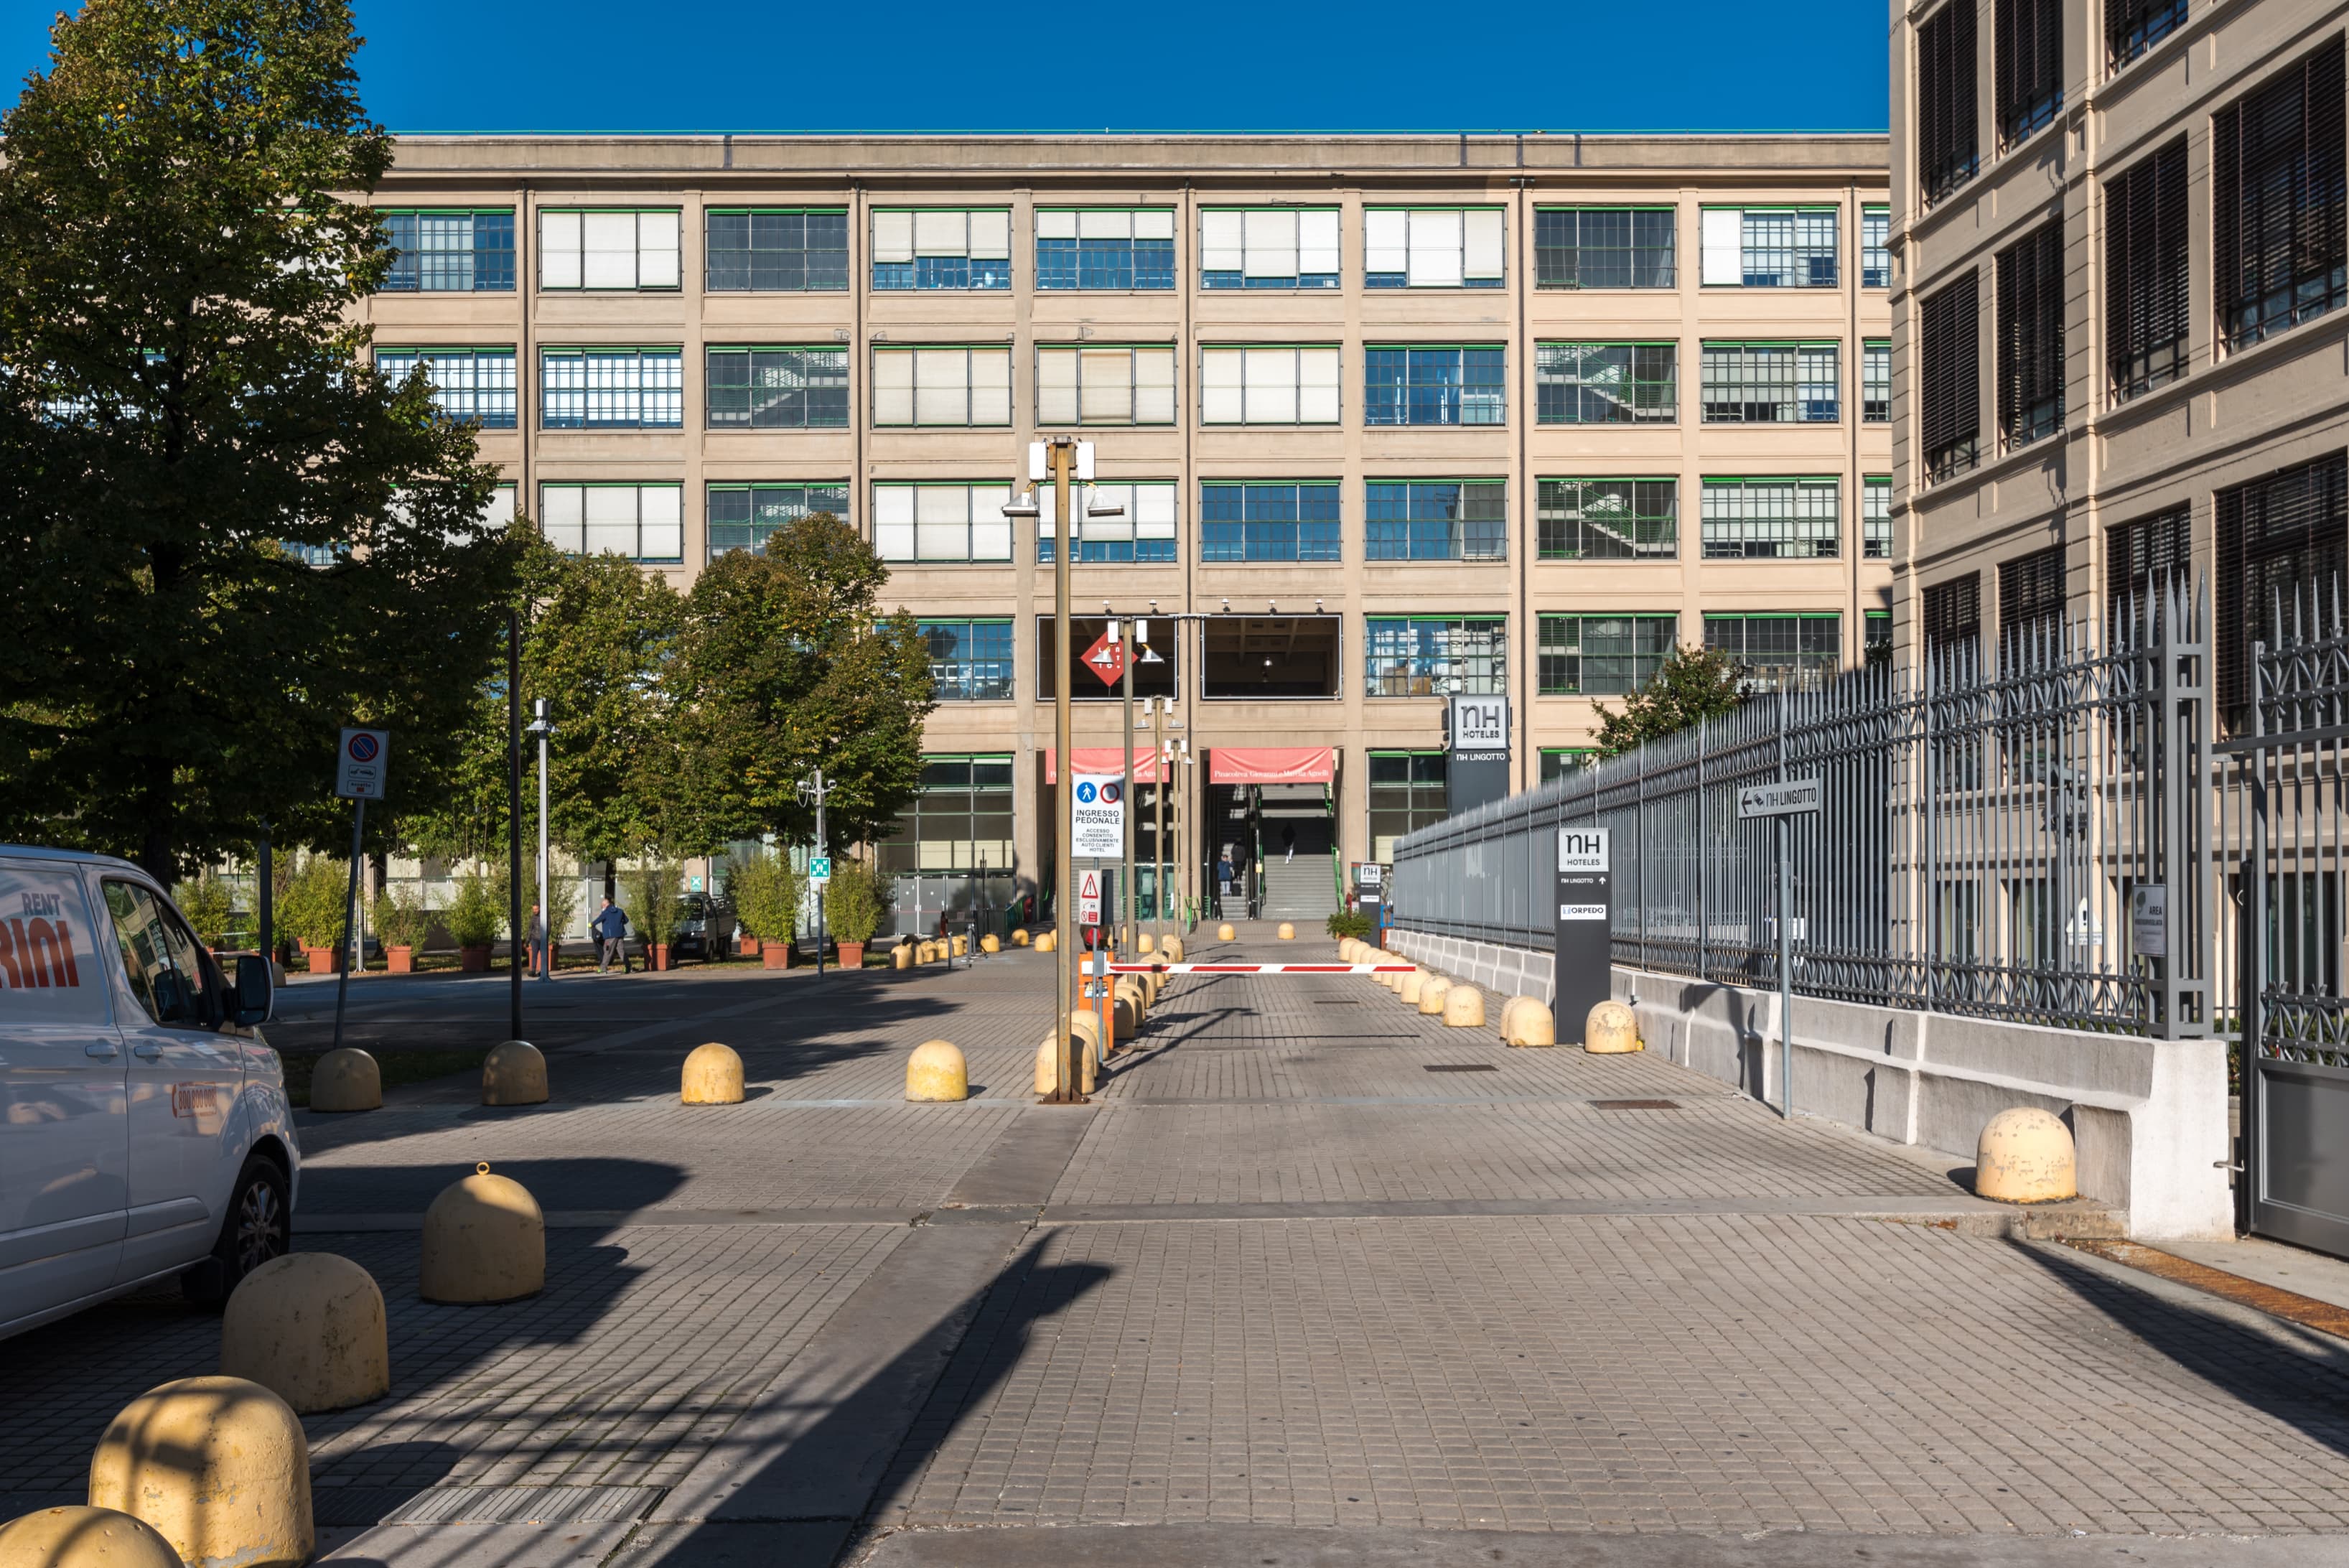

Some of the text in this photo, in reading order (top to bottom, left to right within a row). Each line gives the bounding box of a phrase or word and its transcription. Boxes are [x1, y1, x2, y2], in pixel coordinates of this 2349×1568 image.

[1470, 752, 1505, 761] LINGOTTO
[1780, 788, 1816, 806] LINGOTTO
[22, 892, 60, 916] RENT
[2149, 906, 2162, 915] AREA
